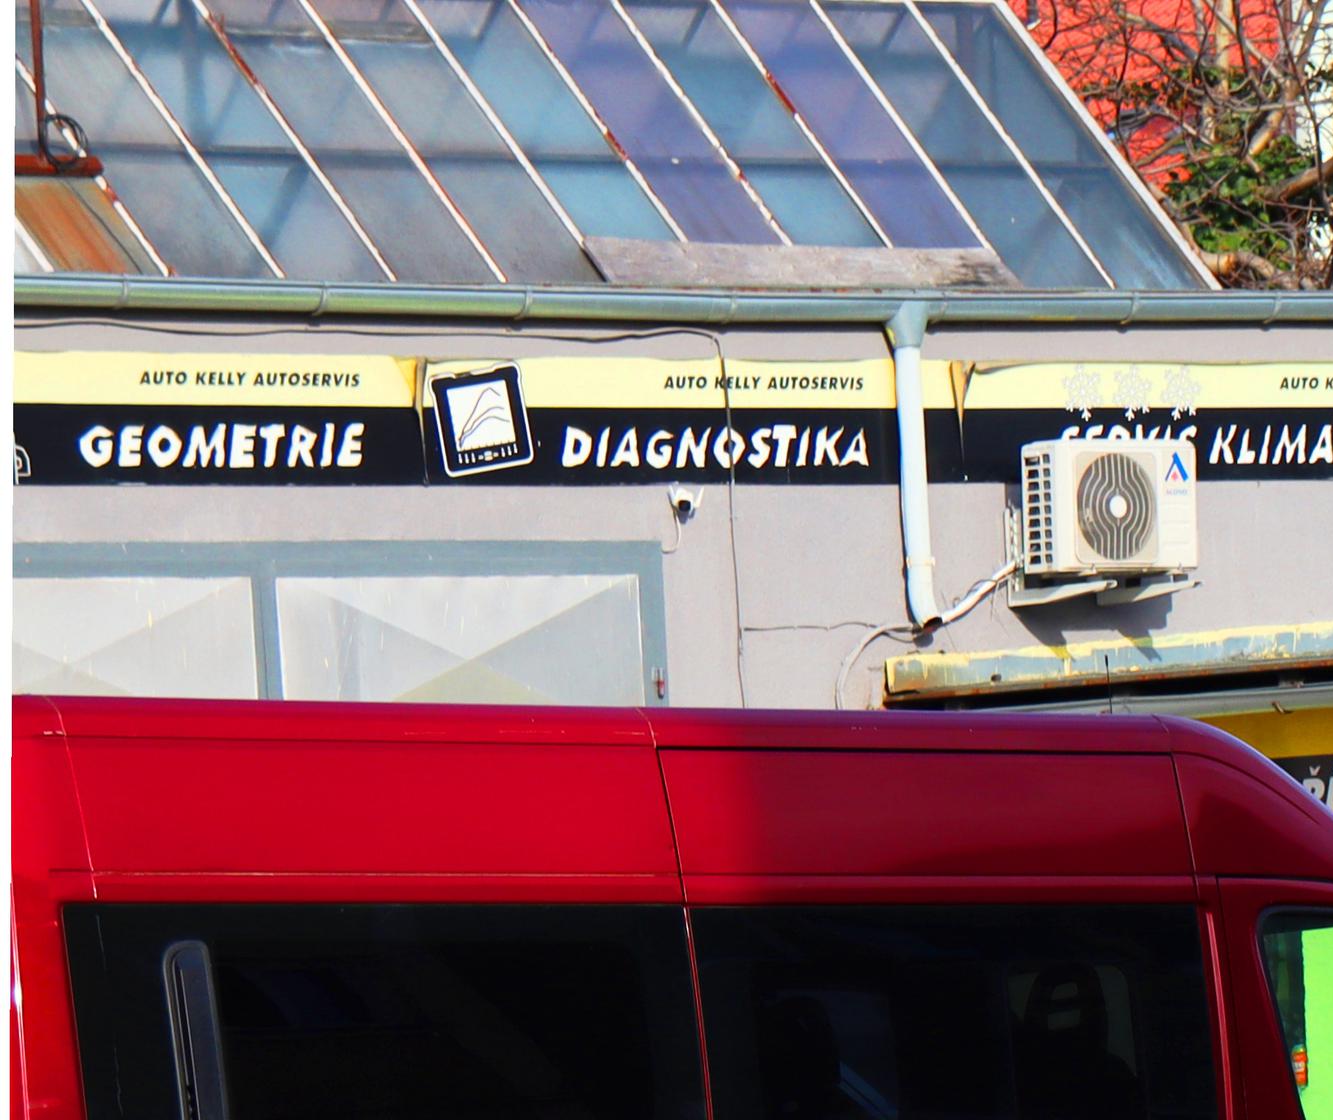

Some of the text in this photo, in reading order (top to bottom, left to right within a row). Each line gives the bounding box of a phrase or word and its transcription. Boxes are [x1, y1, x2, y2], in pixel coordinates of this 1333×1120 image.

[139, 370, 361, 388] AUTO KELLY AUTOSERVIS
[664, 376, 864, 391] AUTO KELLY AUTOSERVIS
[1280, 376, 1319, 390] AUTO
[79, 422, 365, 469] GEOMETRIE
[561, 424, 869, 469] DIAGNOSTIKA
